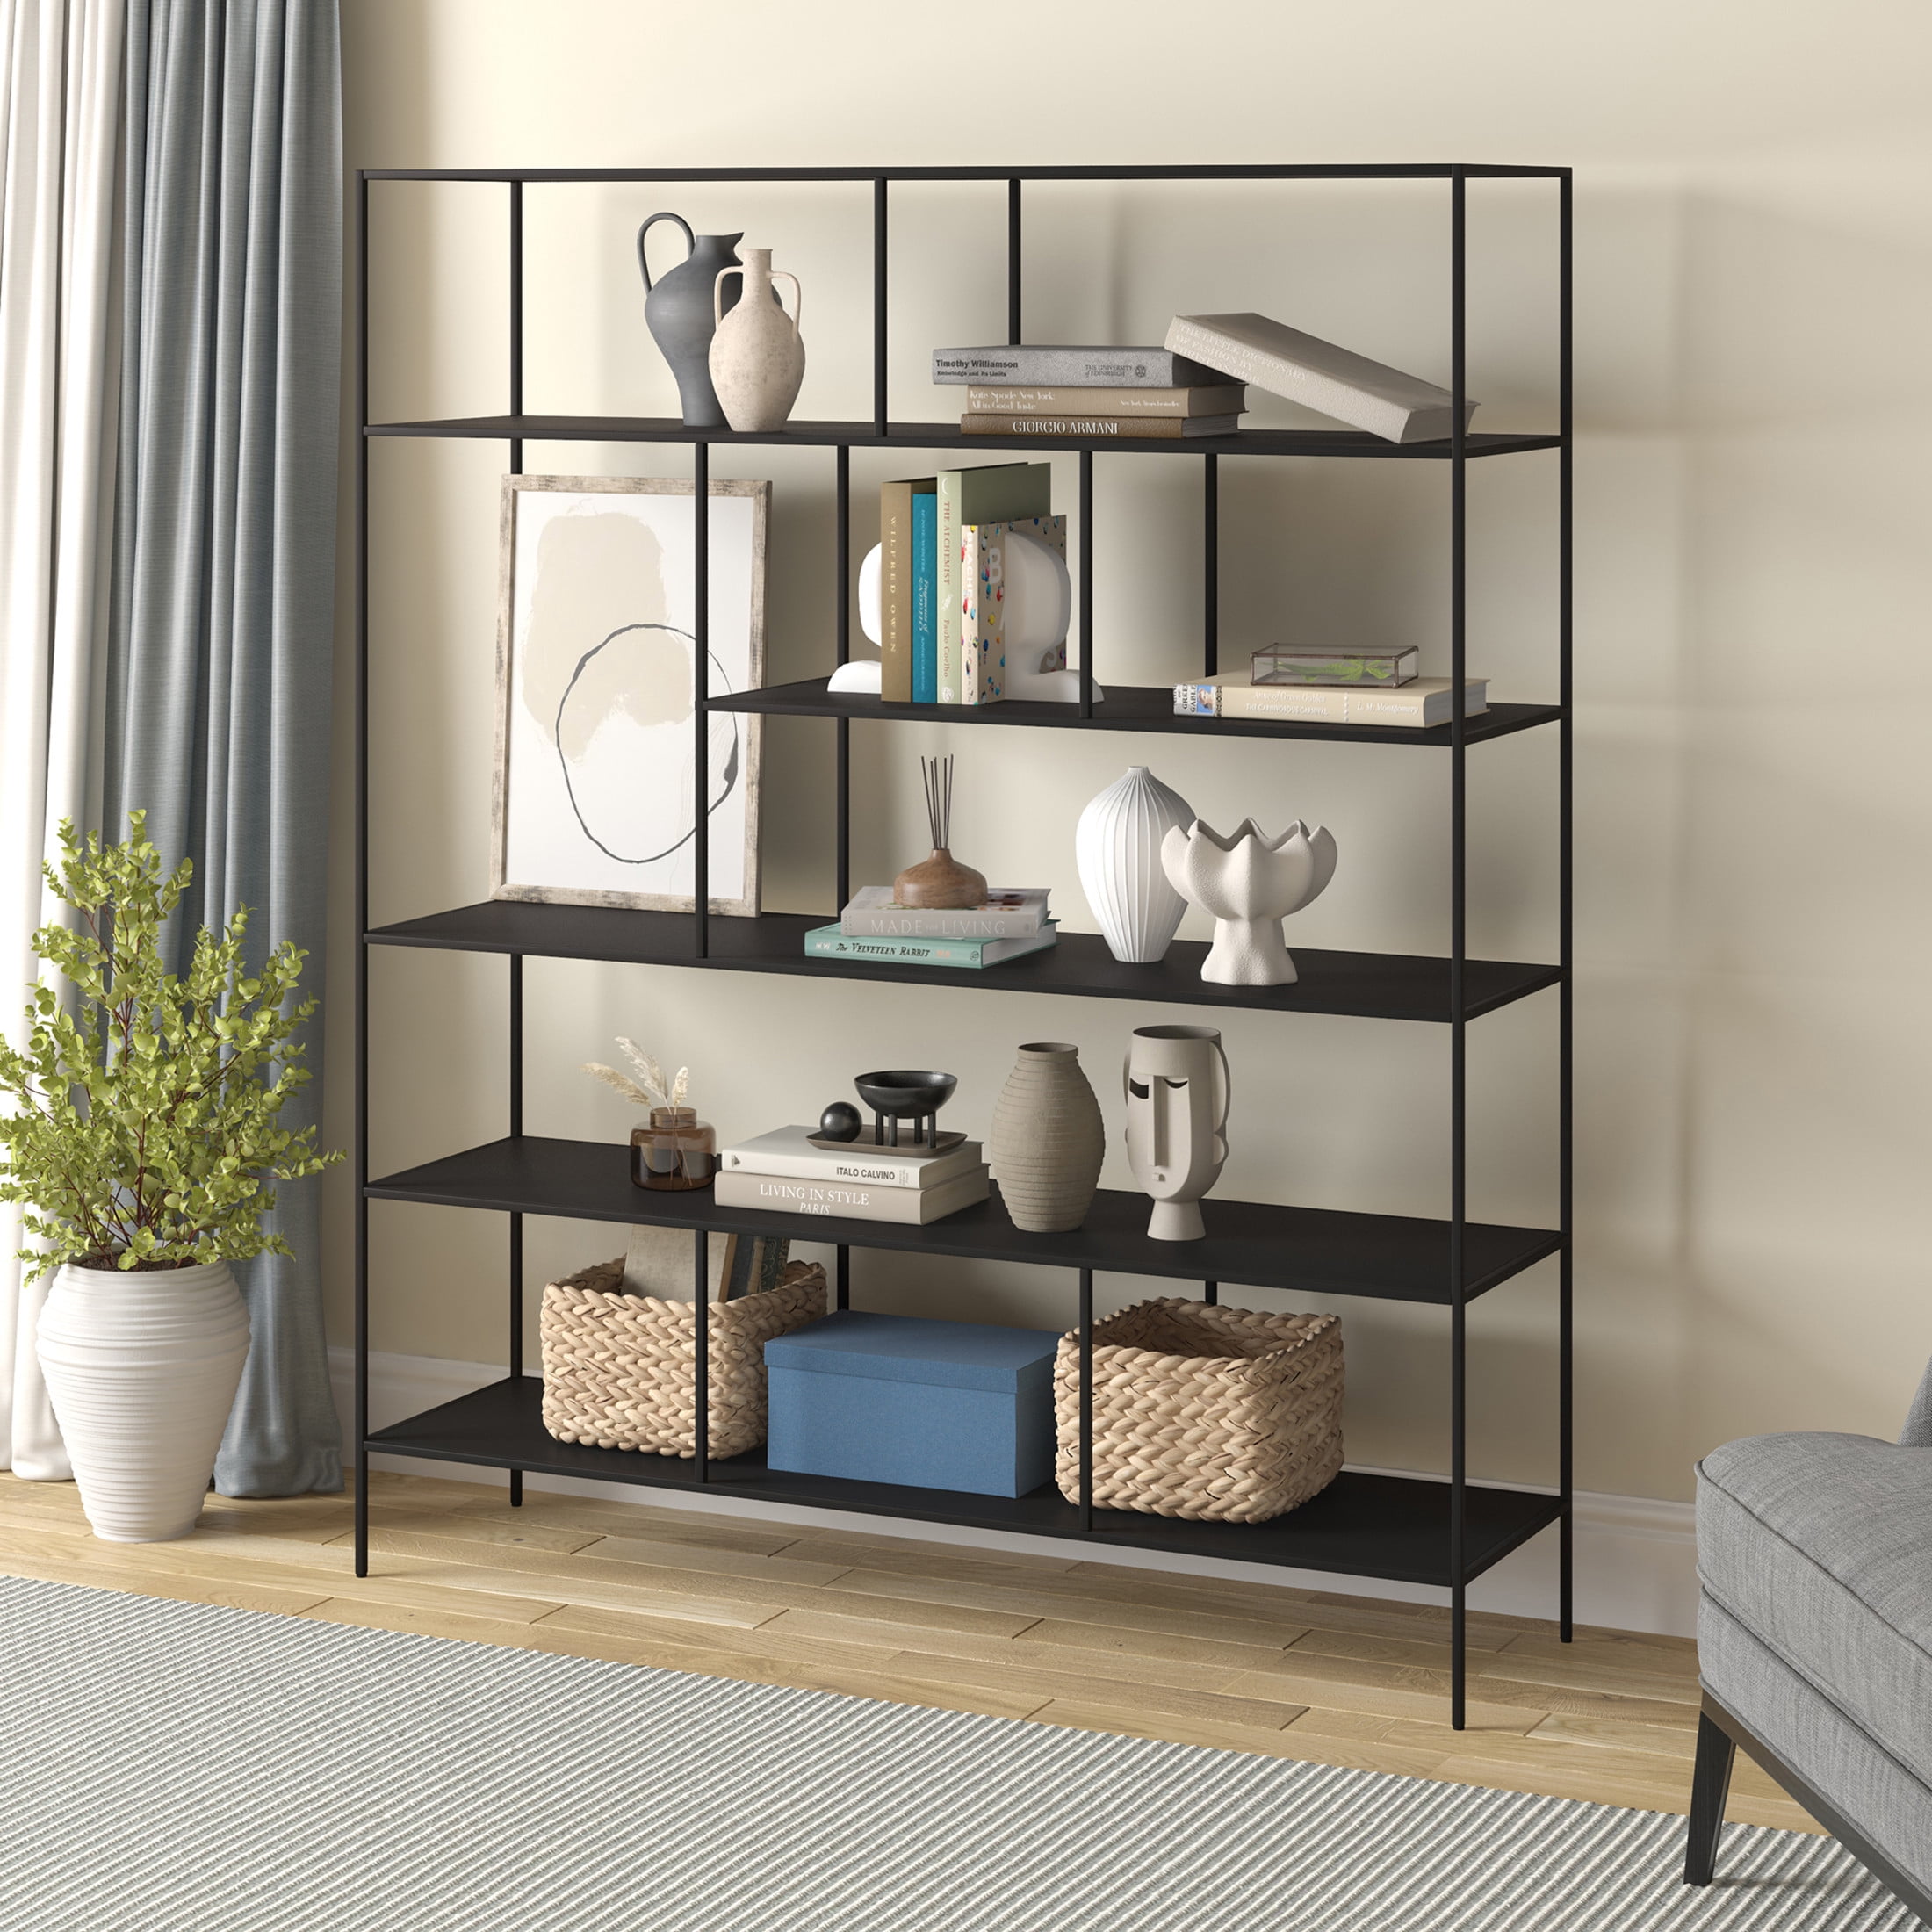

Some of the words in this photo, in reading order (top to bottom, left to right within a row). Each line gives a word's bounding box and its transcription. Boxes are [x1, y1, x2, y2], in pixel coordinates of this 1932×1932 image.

[936, 359, 969, 369] Timothy
[970, 390, 989, 399] Kate
[990, 391, 1017, 403] Spade
[1019, 391, 1034, 400] New
[972, 400, 981, 408] All
[991, 400, 1013, 409] Good
[1016, 400, 1035, 409] Taste
[1013, 421, 1066, 434] GIORGIO
[1067, 422, 1118, 436] ARMANI
[1280, 690, 1301, 701] Green
[1302, 691, 1326, 703] Gables
[1357, 702, 1363, 711] L.
[1365, 703, 1375, 712] M.
[1377, 703, 1418, 716] Montgomery
[871, 919, 922, 934] MADE
[942, 919, 1006, 935] LIVING
[836, 942, 848, 952] The
[852, 942, 897, 955] VELVETEEN
[899, 946, 931, 957] RABBIT
[836, 1166, 859, 1178] ITALO
[861, 1169, 896, 1180] CALVINO
[760, 1183, 805, 1199] LIVING
[809, 1187, 824, 1200] IN
[828, 1190, 869, 1207] STYLE
[799, 1202, 831, 1215] PARIS
